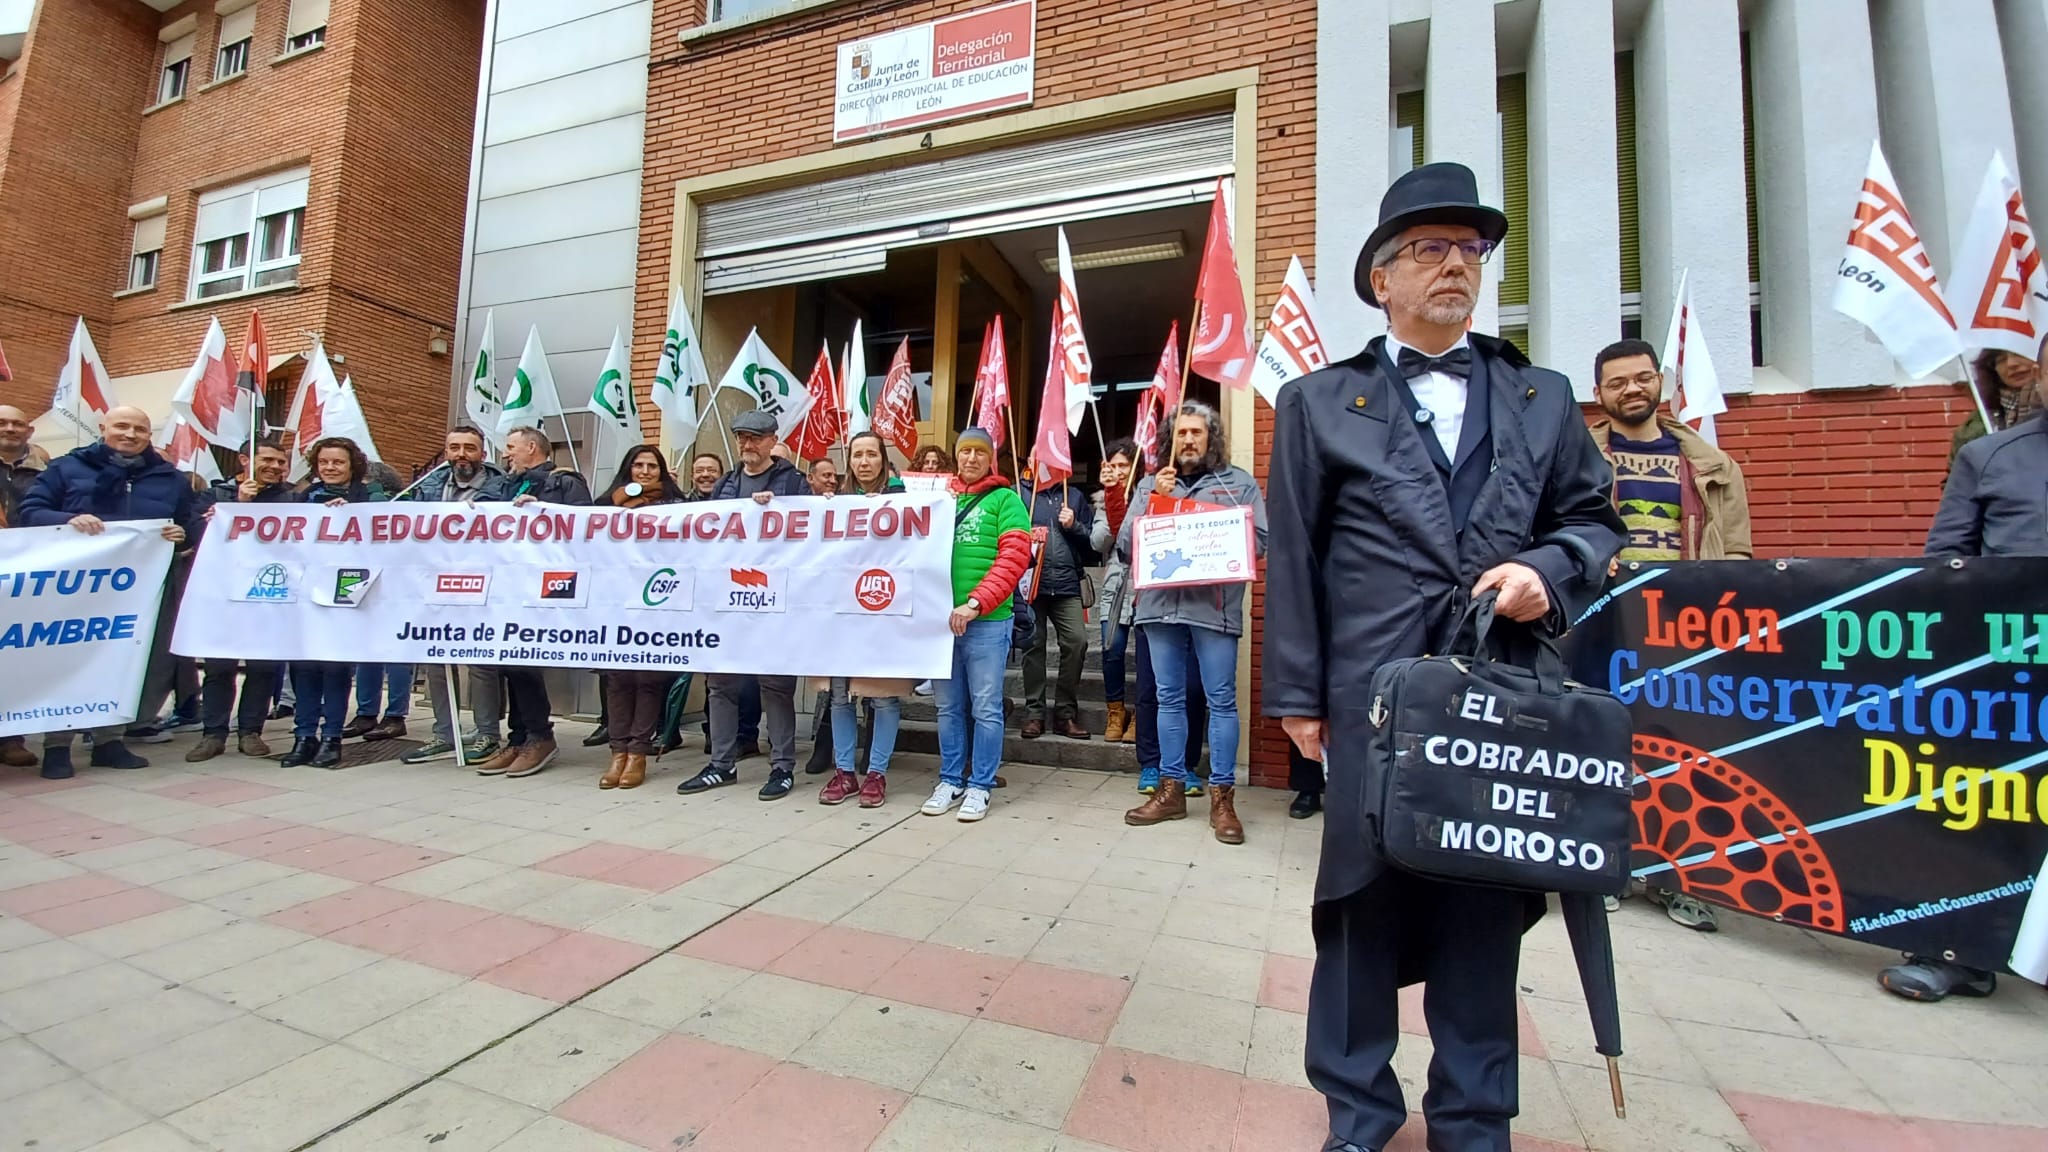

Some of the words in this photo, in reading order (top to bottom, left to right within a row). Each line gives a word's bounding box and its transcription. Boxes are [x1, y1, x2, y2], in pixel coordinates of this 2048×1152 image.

[938, 29, 1013, 58] Delegación
[875, 61, 904, 77] Junta
[905, 58, 920, 69] de
[937, 48, 1006, 74] Territorial
[839, 93, 890, 113] DIRECCIÓN
[891, 81, 949, 101] PROVINCIAL
[952, 76, 965, 89] DE
[968, 63, 1028, 85] EDUCACIÓN
[847, 77, 883, 93] Castilla
[885, 76, 892, 88] y
[893, 68, 919, 83] León
[916, 95, 942, 110] LEÓN
[920, 132, 933, 149] 4
[1259, 347, 1288, 380] León
[228, 514, 308, 542] POR
[316, 515, 363, 542] LA
[371, 508, 576, 542] EDUCACIÓN
[585, 506, 748, 541] PÚBLICA
[760, 509, 809, 540] DE
[823, 501, 931, 540] LEÓN
[247, 586, 289, 597] ANPE
[440, 578, 483, 589] CCOO
[547, 580, 572, 591] CGT
[650, 580, 680, 593] CSIF
[860, 575, 891, 599] UGT
[729, 591, 776, 610] STECyL-i
[397, 621, 465, 641] Junta
[473, 622, 495, 641] de
[502, 623, 607, 645] Personal
[616, 626, 720, 648] Docente
[1641, 589, 1783, 654] León
[1821, 610, 1941, 671] por
[427, 646, 445, 657] de
[449, 648, 495, 658] centros
[499, 647, 565, 662] públicos
[570, 651, 588, 661] no
[591, 650, 689, 665] univesitarios
[1460, 692, 1504, 724] EL
[1608, 648, 2048, 743] Conservatori
[1424, 736, 1626, 788] COBRADOR
[1492, 783, 1556, 819] DEL
[1440, 821, 1605, 871] MOROSO
[1849, 875, 2036, 934] #LeónPorUnConservatori
